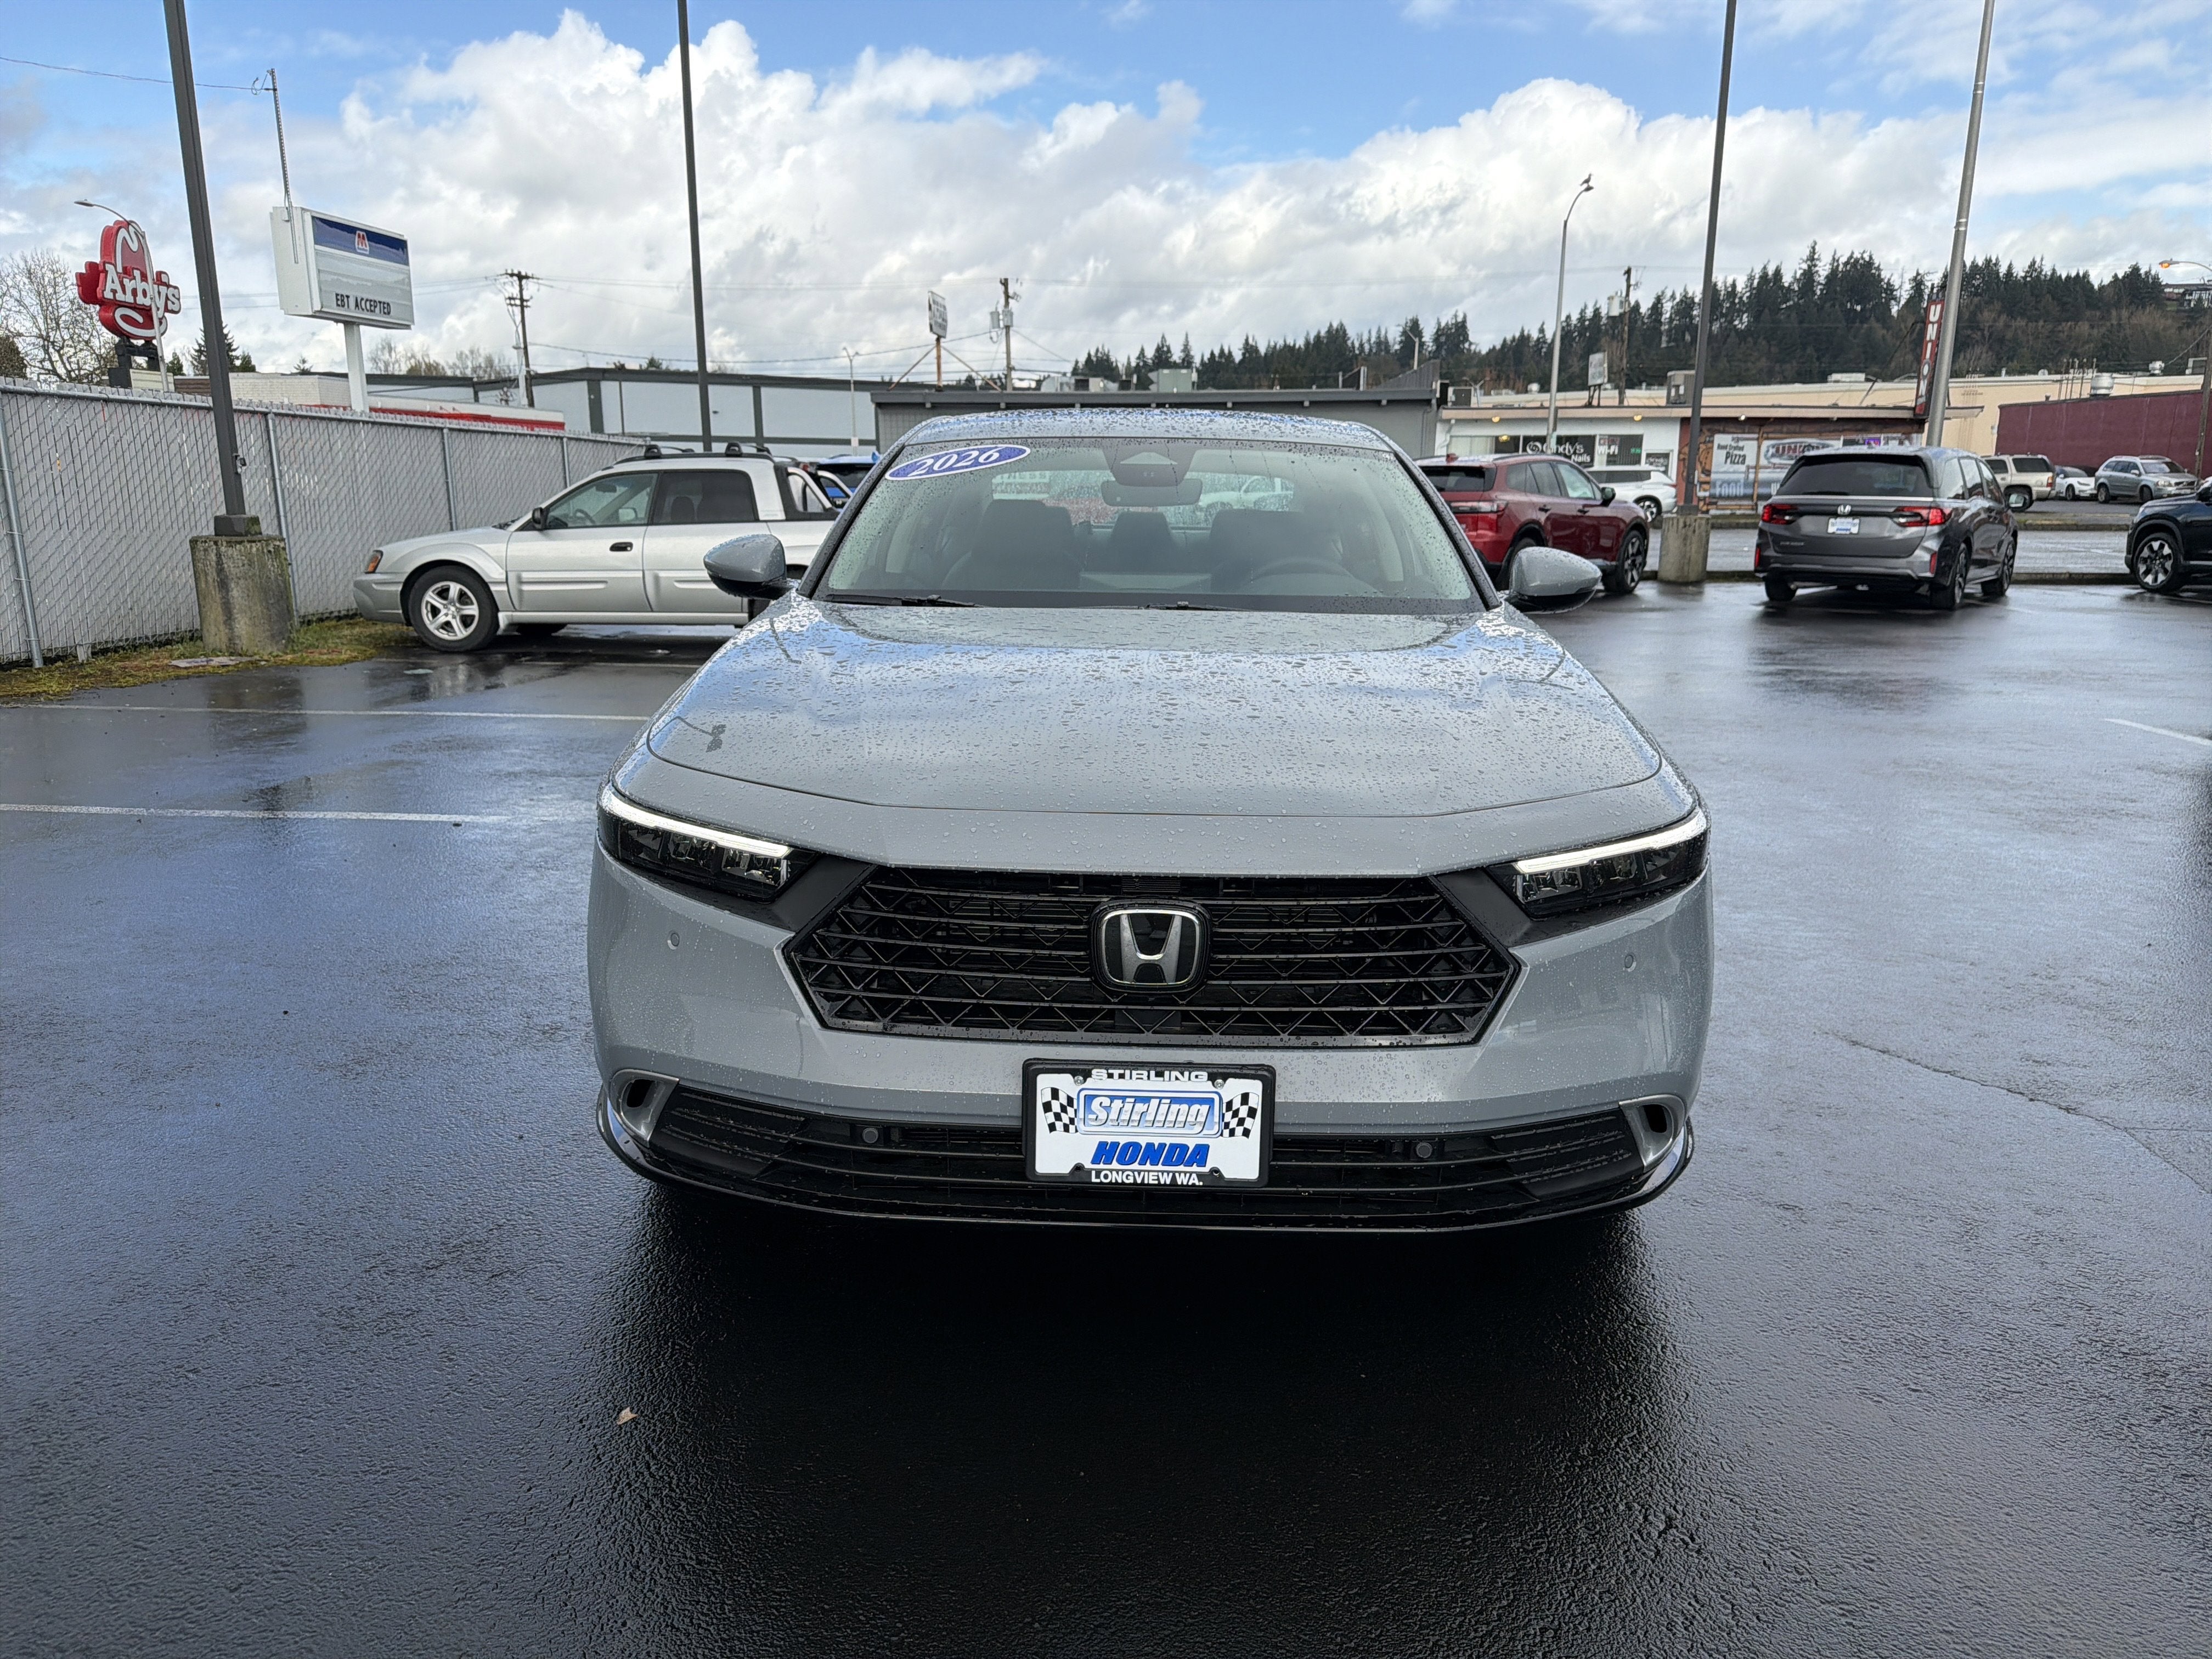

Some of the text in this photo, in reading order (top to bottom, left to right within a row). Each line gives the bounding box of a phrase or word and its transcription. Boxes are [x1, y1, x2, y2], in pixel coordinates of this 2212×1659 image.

[104, 263, 180, 318] Arby's
[335, 292, 391, 315] EBT ACCEPTED
[1918, 303, 1942, 396] UNION
[907, 446, 1006, 477] 2026
[1724, 451, 1747, 465] Pizza
[1091, 1069, 1209, 1082] STIRLING
[1088, 1096, 1211, 1134] Stirling
[1090, 1140, 1210, 1168] HONDA
[1091, 1170, 1204, 1186] LONGVIEW WA.
